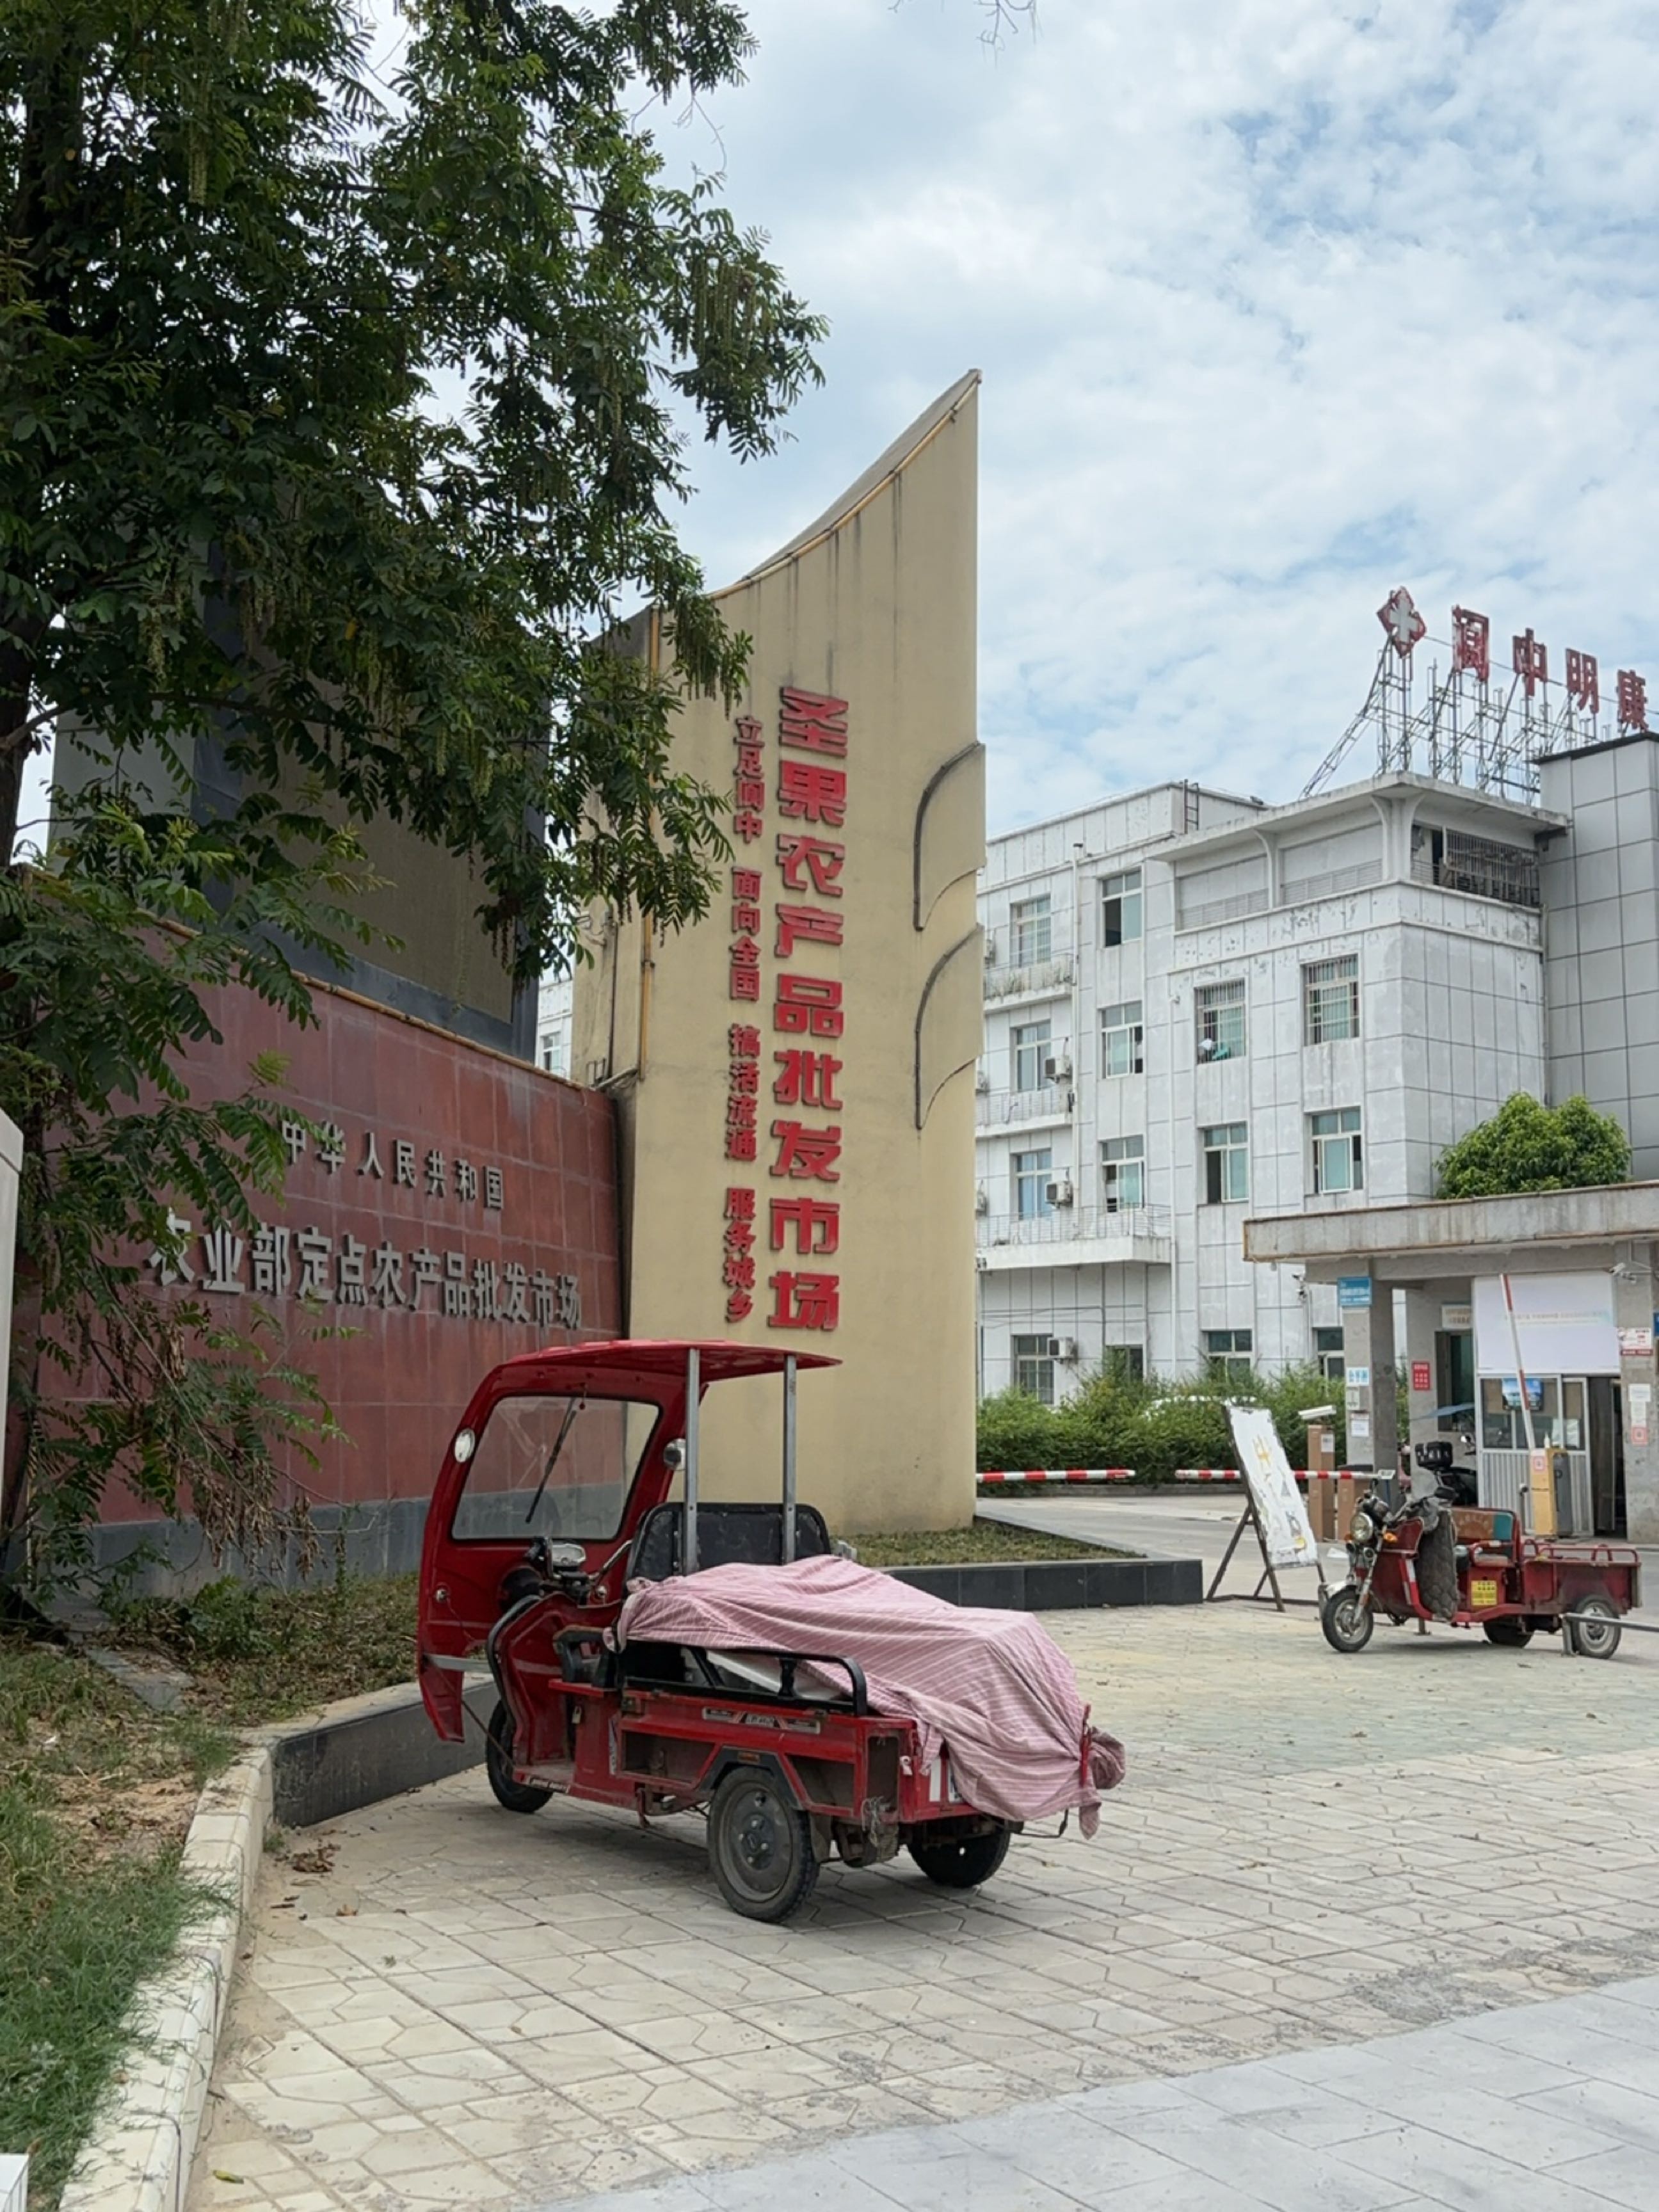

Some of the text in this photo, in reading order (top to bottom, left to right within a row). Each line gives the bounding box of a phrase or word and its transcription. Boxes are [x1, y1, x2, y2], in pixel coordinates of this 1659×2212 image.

[282, 1119, 504, 1210] 中华人民共和国
[721, 715, 765, 1323] 立足阆中 面向全国 搞活流通 服务城乡
[767, 686, 849, 1331] 圣果农产品批发市场
